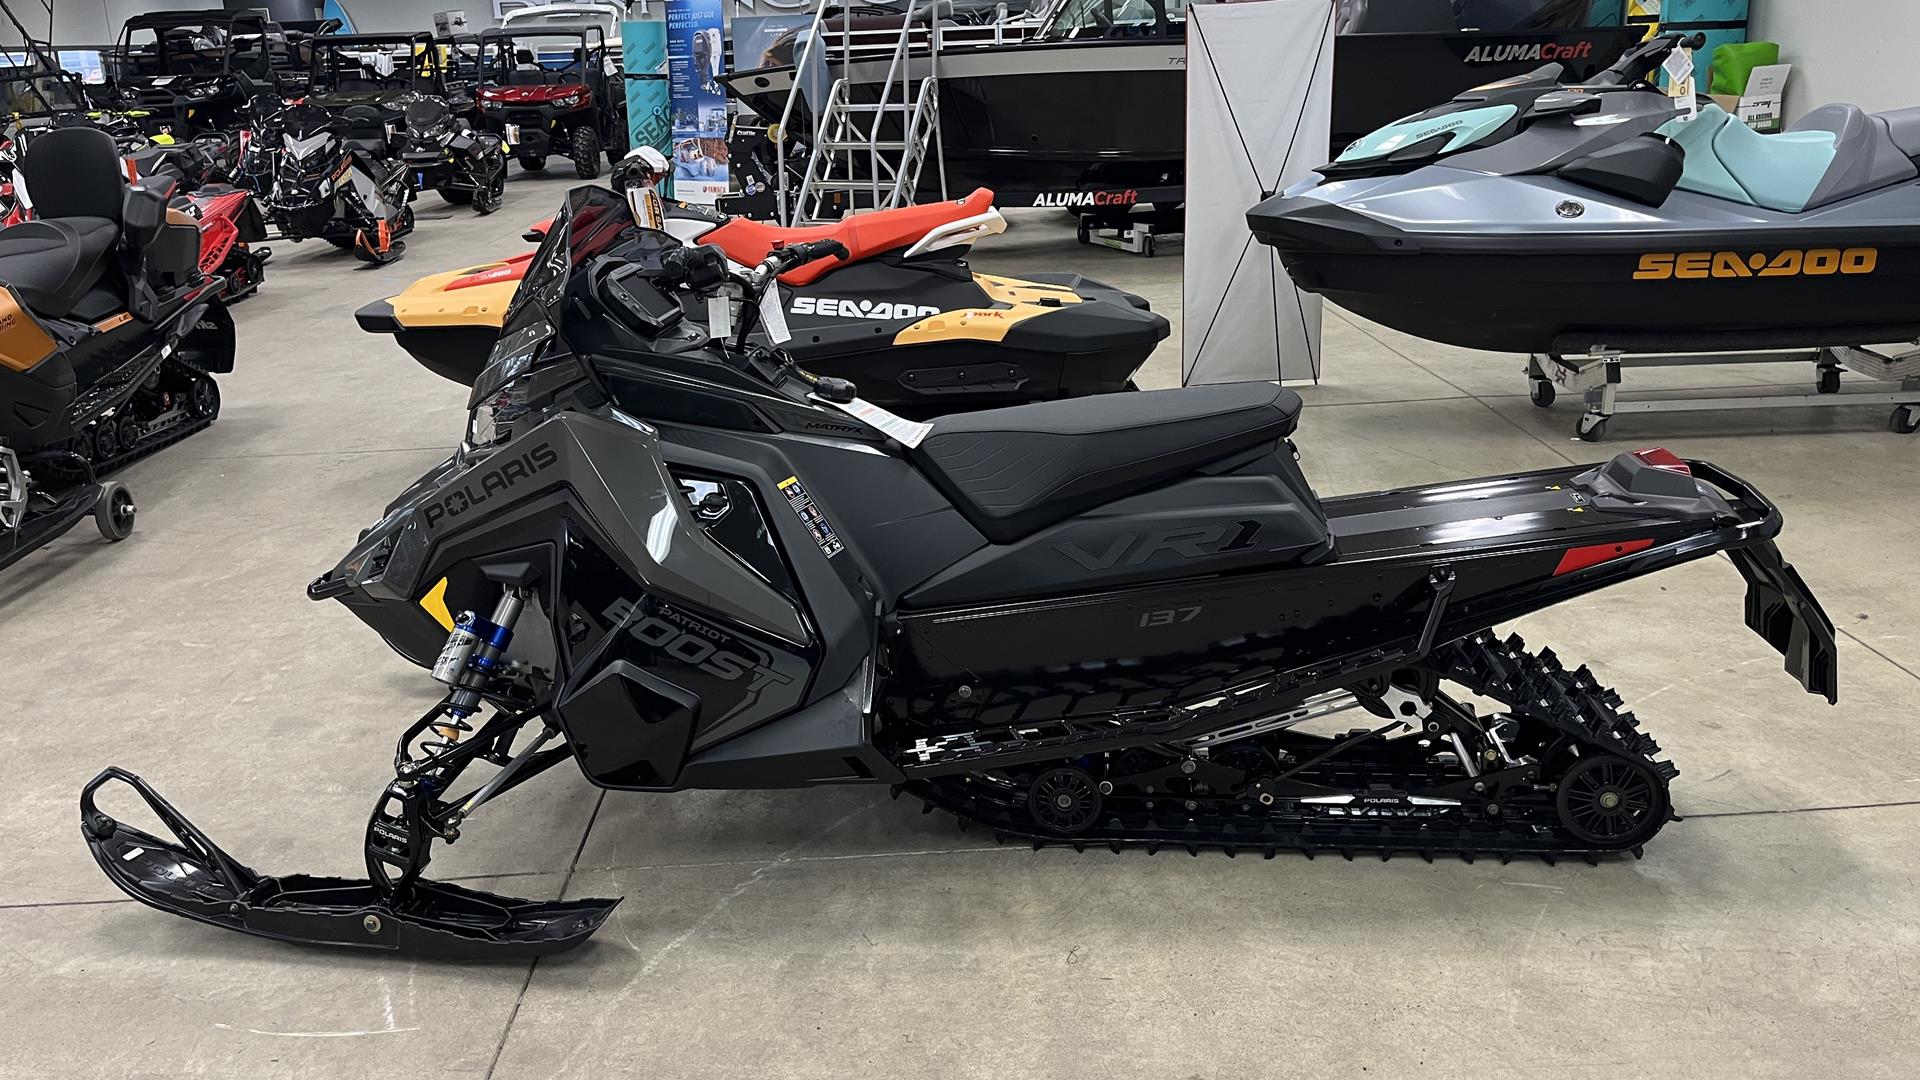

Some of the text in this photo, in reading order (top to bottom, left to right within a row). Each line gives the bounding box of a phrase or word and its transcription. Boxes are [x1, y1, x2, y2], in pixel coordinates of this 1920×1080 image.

[668, 13, 691, 21] PERFECT
[1464, 41, 1592, 62] ALUMACraft
[1032, 189, 1138, 206] ALUMACraft
[804, 422, 864, 435] MATRYX
[423, 441, 558, 529] POLARIS
[1052, 519, 1265, 571] VR1
[658, 606, 731, 644] PATRIOT
[1139, 605, 1203, 628] 137
[601, 596, 794, 693] BOOST
[373, 826, 408, 844] POLARIS
